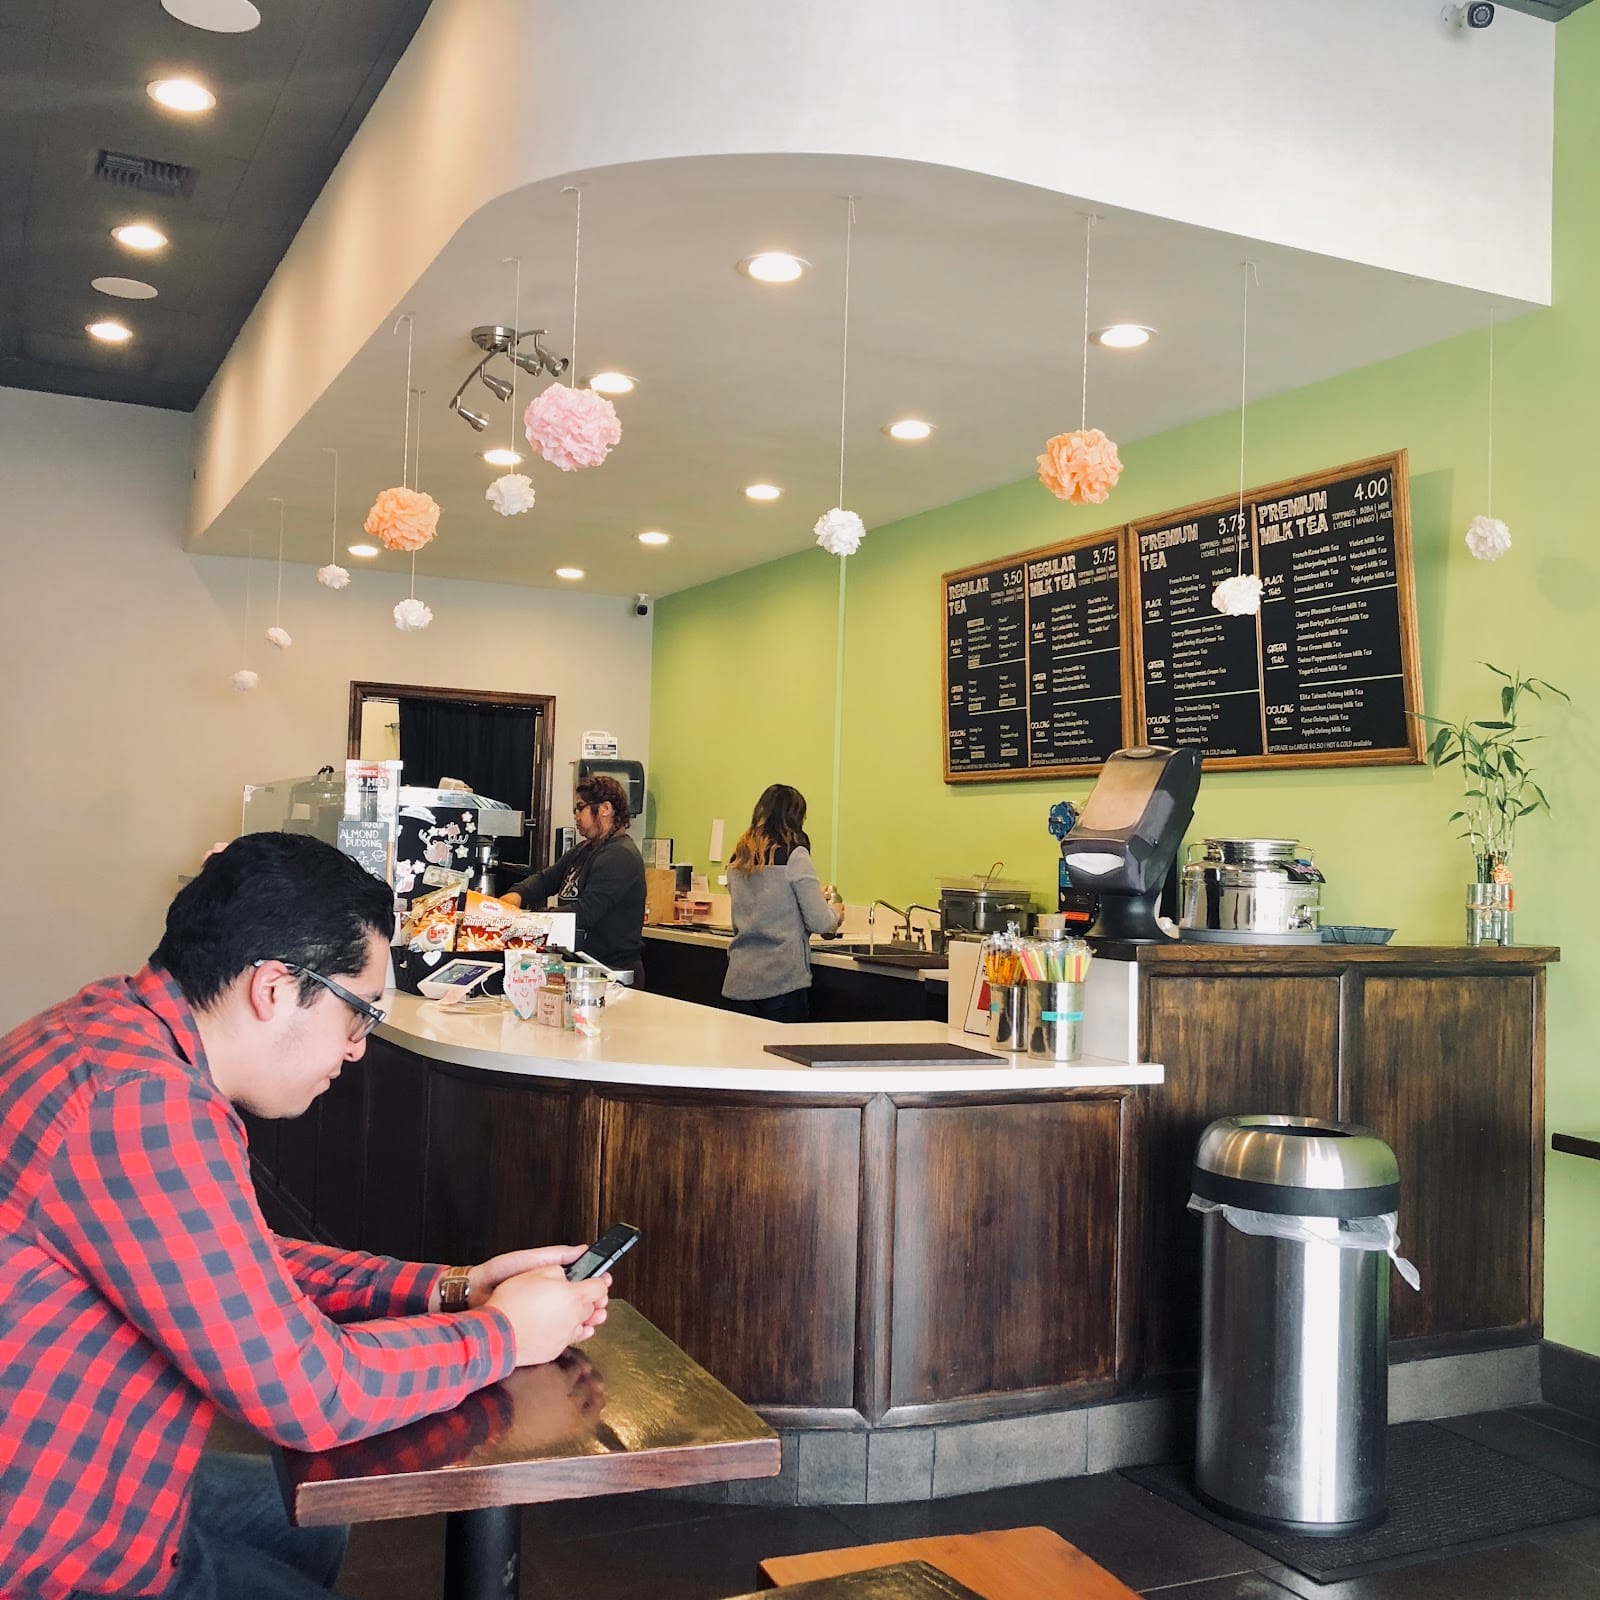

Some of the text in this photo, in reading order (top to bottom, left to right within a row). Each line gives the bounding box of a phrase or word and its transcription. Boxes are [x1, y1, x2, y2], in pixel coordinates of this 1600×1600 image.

[1354, 478, 1387, 501] 4.00
[1258, 491, 1327, 524] PREMIUM
[1380, 510, 1393, 519] ALOE
[1218, 513, 1245, 534] 3.75
[1260, 513, 1328, 546] MILK TEA
[1140, 523, 1198, 553] PREMIUM
[1093, 546, 1116, 565] 3.75
[1141, 551, 1167, 572] TEA
[1029, 555, 1076, 580] REGULAR
[1003, 570, 1022, 586] 3.50
[1030, 578, 1053, 597] MILK
[1054, 573, 1076, 591] TEA
[1264, 574, 1284, 586] BLACK
[949, 577, 989, 600] REGULAR
[949, 599, 966, 616] TEA
[1295, 610, 1310, 618] Cherry
[1266, 704, 1294, 715] OOLONG
[340, 829, 378, 839] ALMOND
[346, 840, 382, 848] PUDDING
[464, 915, 489, 926] Shrimp
